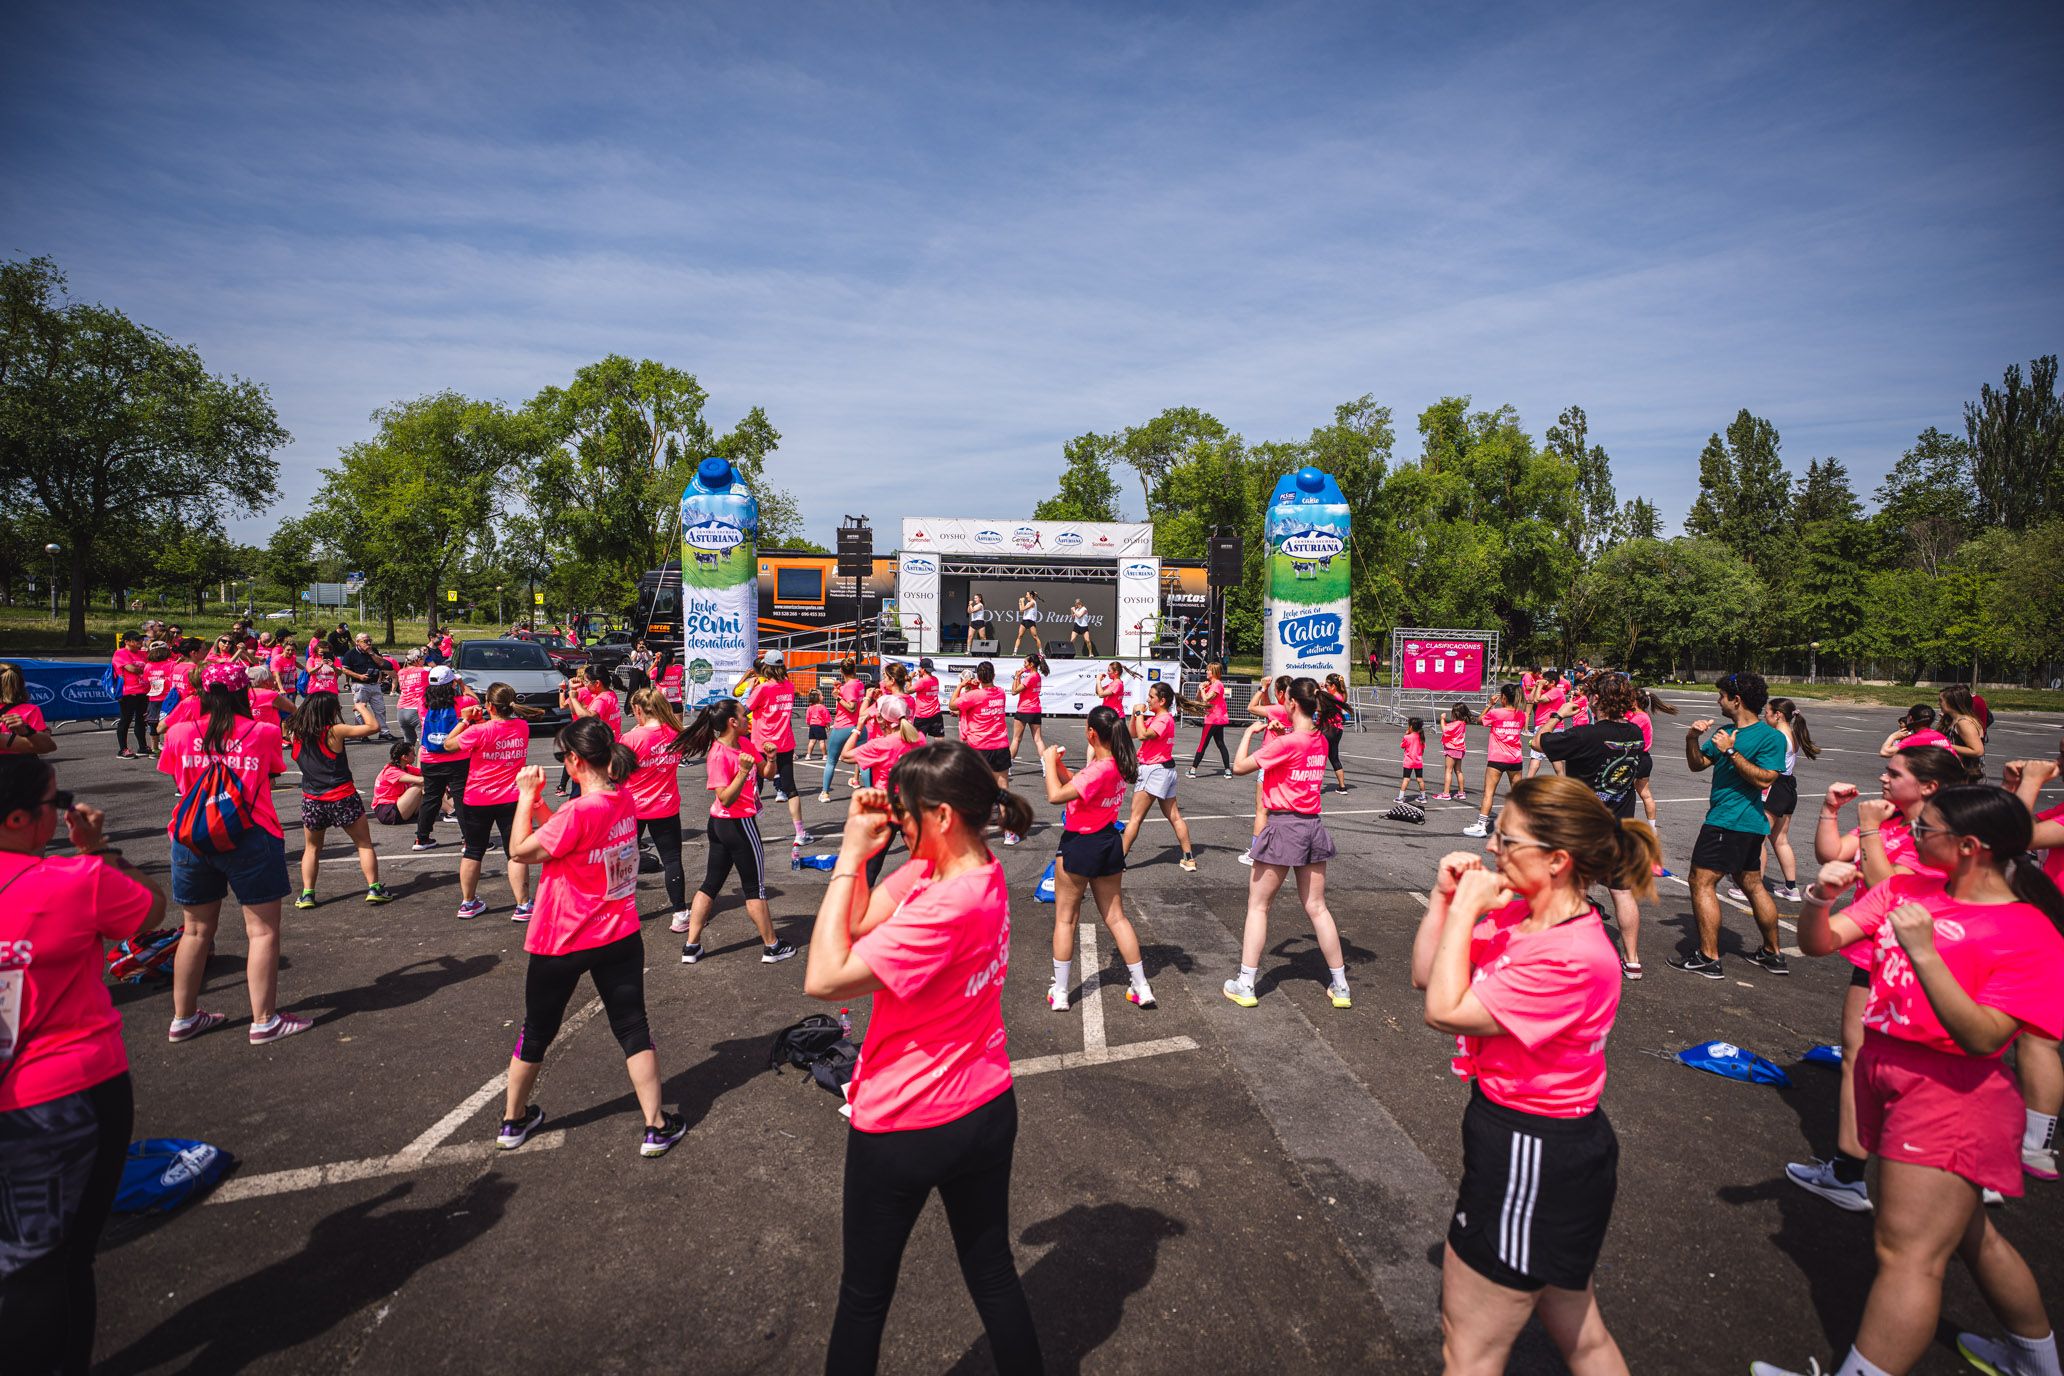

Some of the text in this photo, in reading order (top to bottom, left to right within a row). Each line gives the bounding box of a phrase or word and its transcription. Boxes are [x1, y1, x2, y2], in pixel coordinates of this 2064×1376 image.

[688, 531, 740, 543] ASTURIANA
[1284, 541, 1339, 552] ASTURIANA
[903, 592, 934, 600] OYSHO
[689, 598, 718, 616] Leche
[1282, 610, 1298, 620] Leche
[687, 612, 745, 635] semi
[1284, 619, 1335, 645] Calcio
[688, 634, 746, 649] desnatada
[1306, 642, 1334, 655] natural
[1285, 661, 1334, 670] semidesnatada
[68, 688, 109, 699] ASTURI
[495, 738, 524, 750] SOMOS
[482, 749, 528, 760] IMPARABLE
